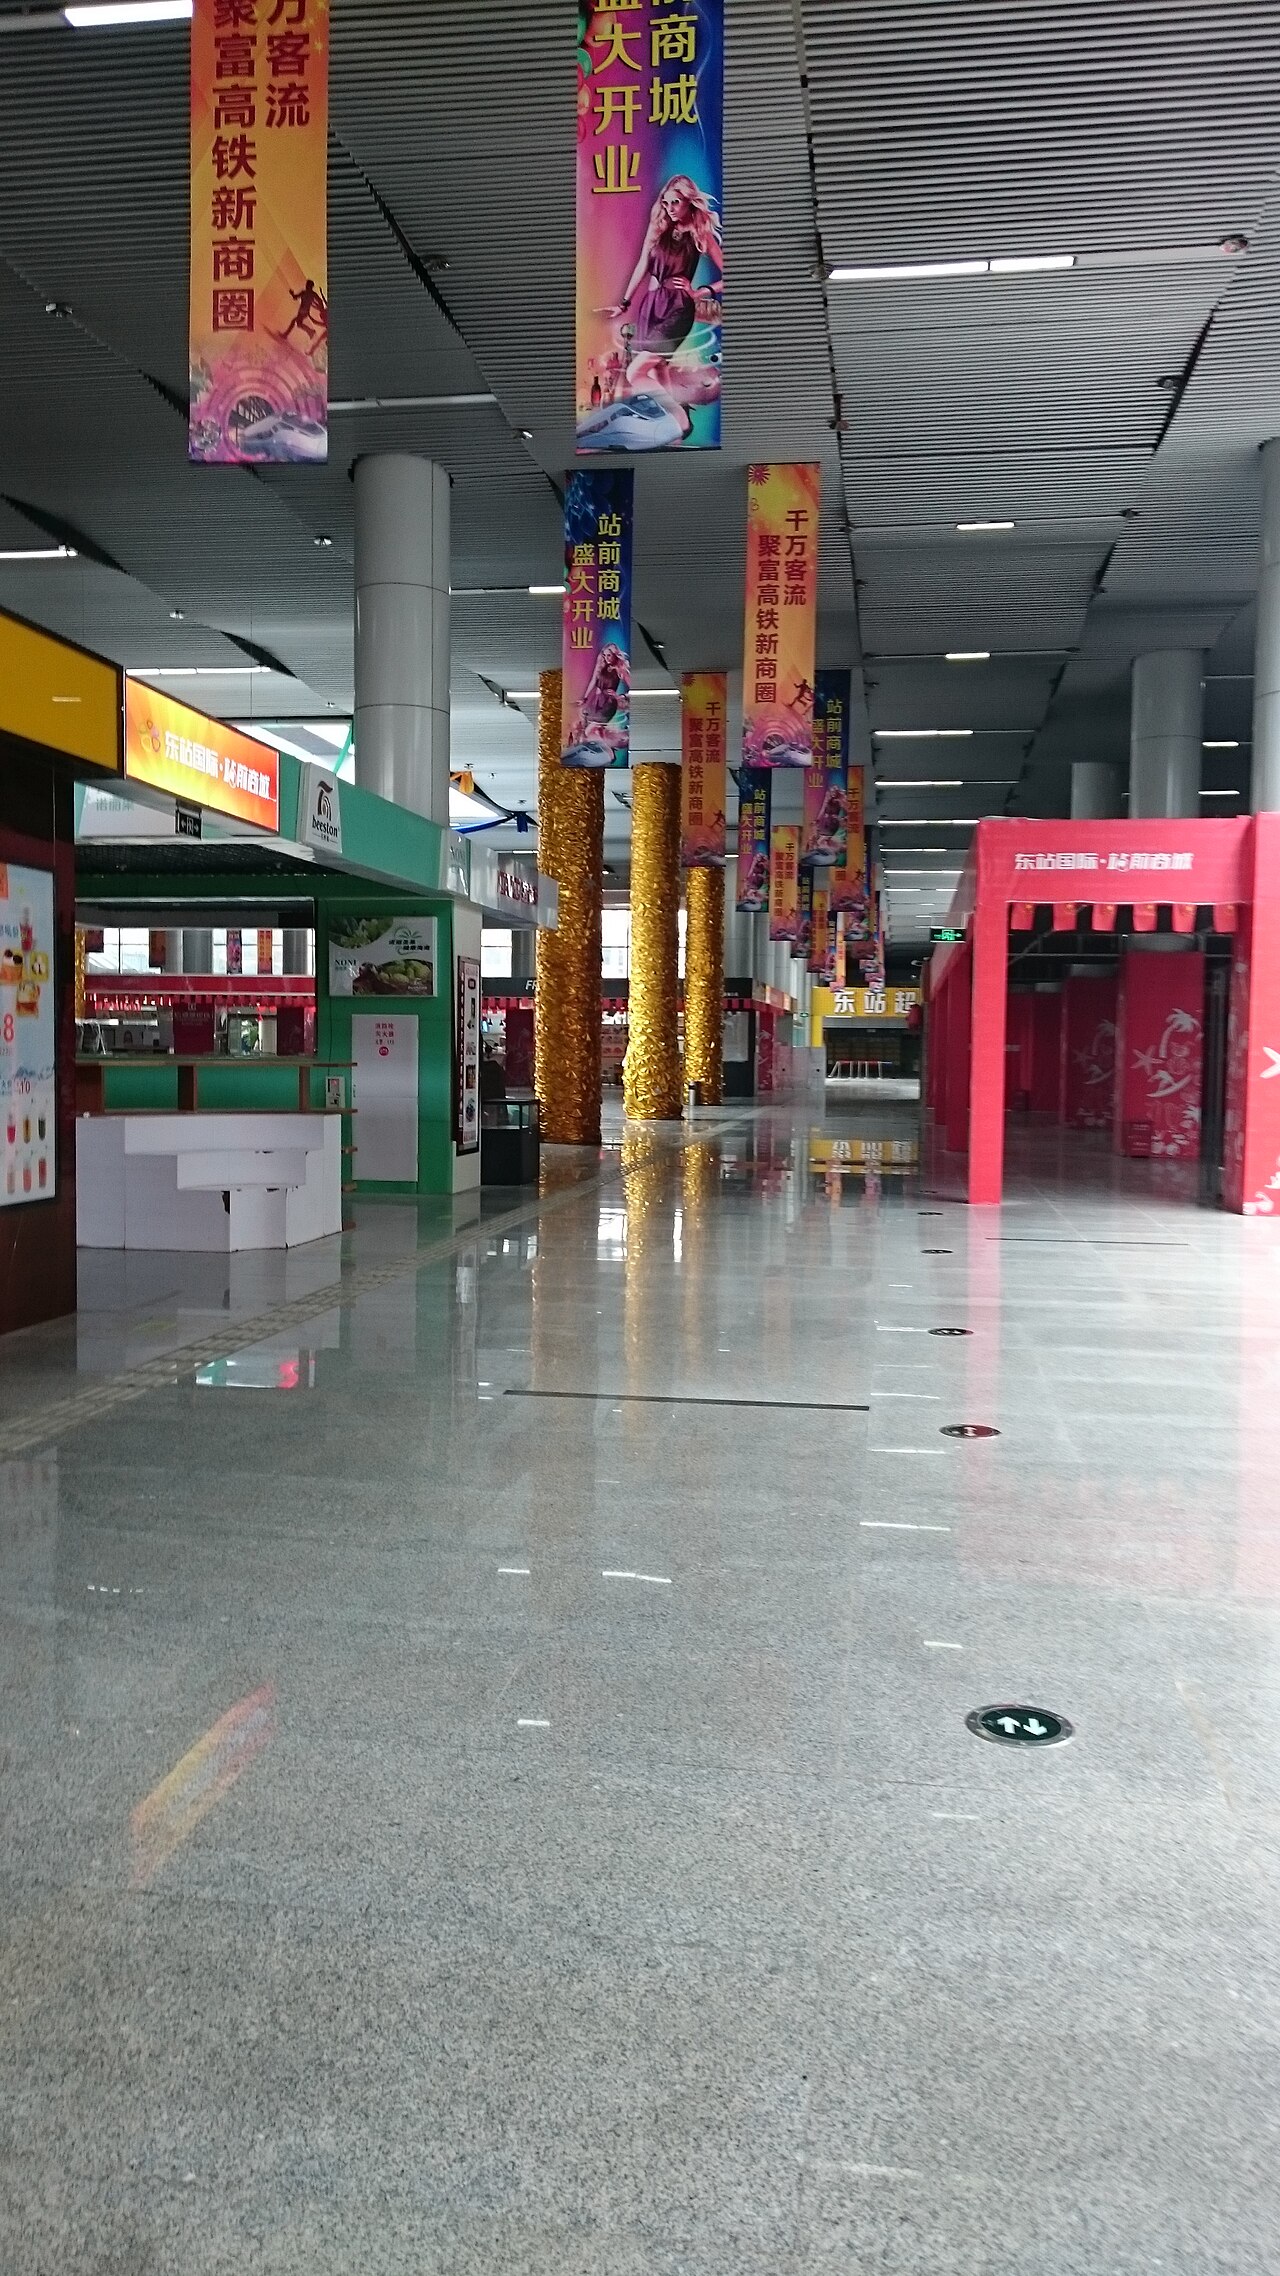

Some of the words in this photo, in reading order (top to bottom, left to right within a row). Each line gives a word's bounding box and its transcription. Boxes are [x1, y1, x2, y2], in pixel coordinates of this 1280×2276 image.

[649, 0, 699, 126] 商城
[571, 543, 595, 651] 盛大开业
[597, 513, 621, 621] 站前商城
[784, 508, 809, 606] 千万客流
[755, 534, 781, 704] 聚富高铁新商圈
[688, 717, 704, 826] 聚富高铁新商圈
[705, 701, 721, 763] 千万客流
[826, 699, 843, 769] 站前商城
[312, 814, 338, 837] beeston
[753, 788, 767, 841] 站前商城
